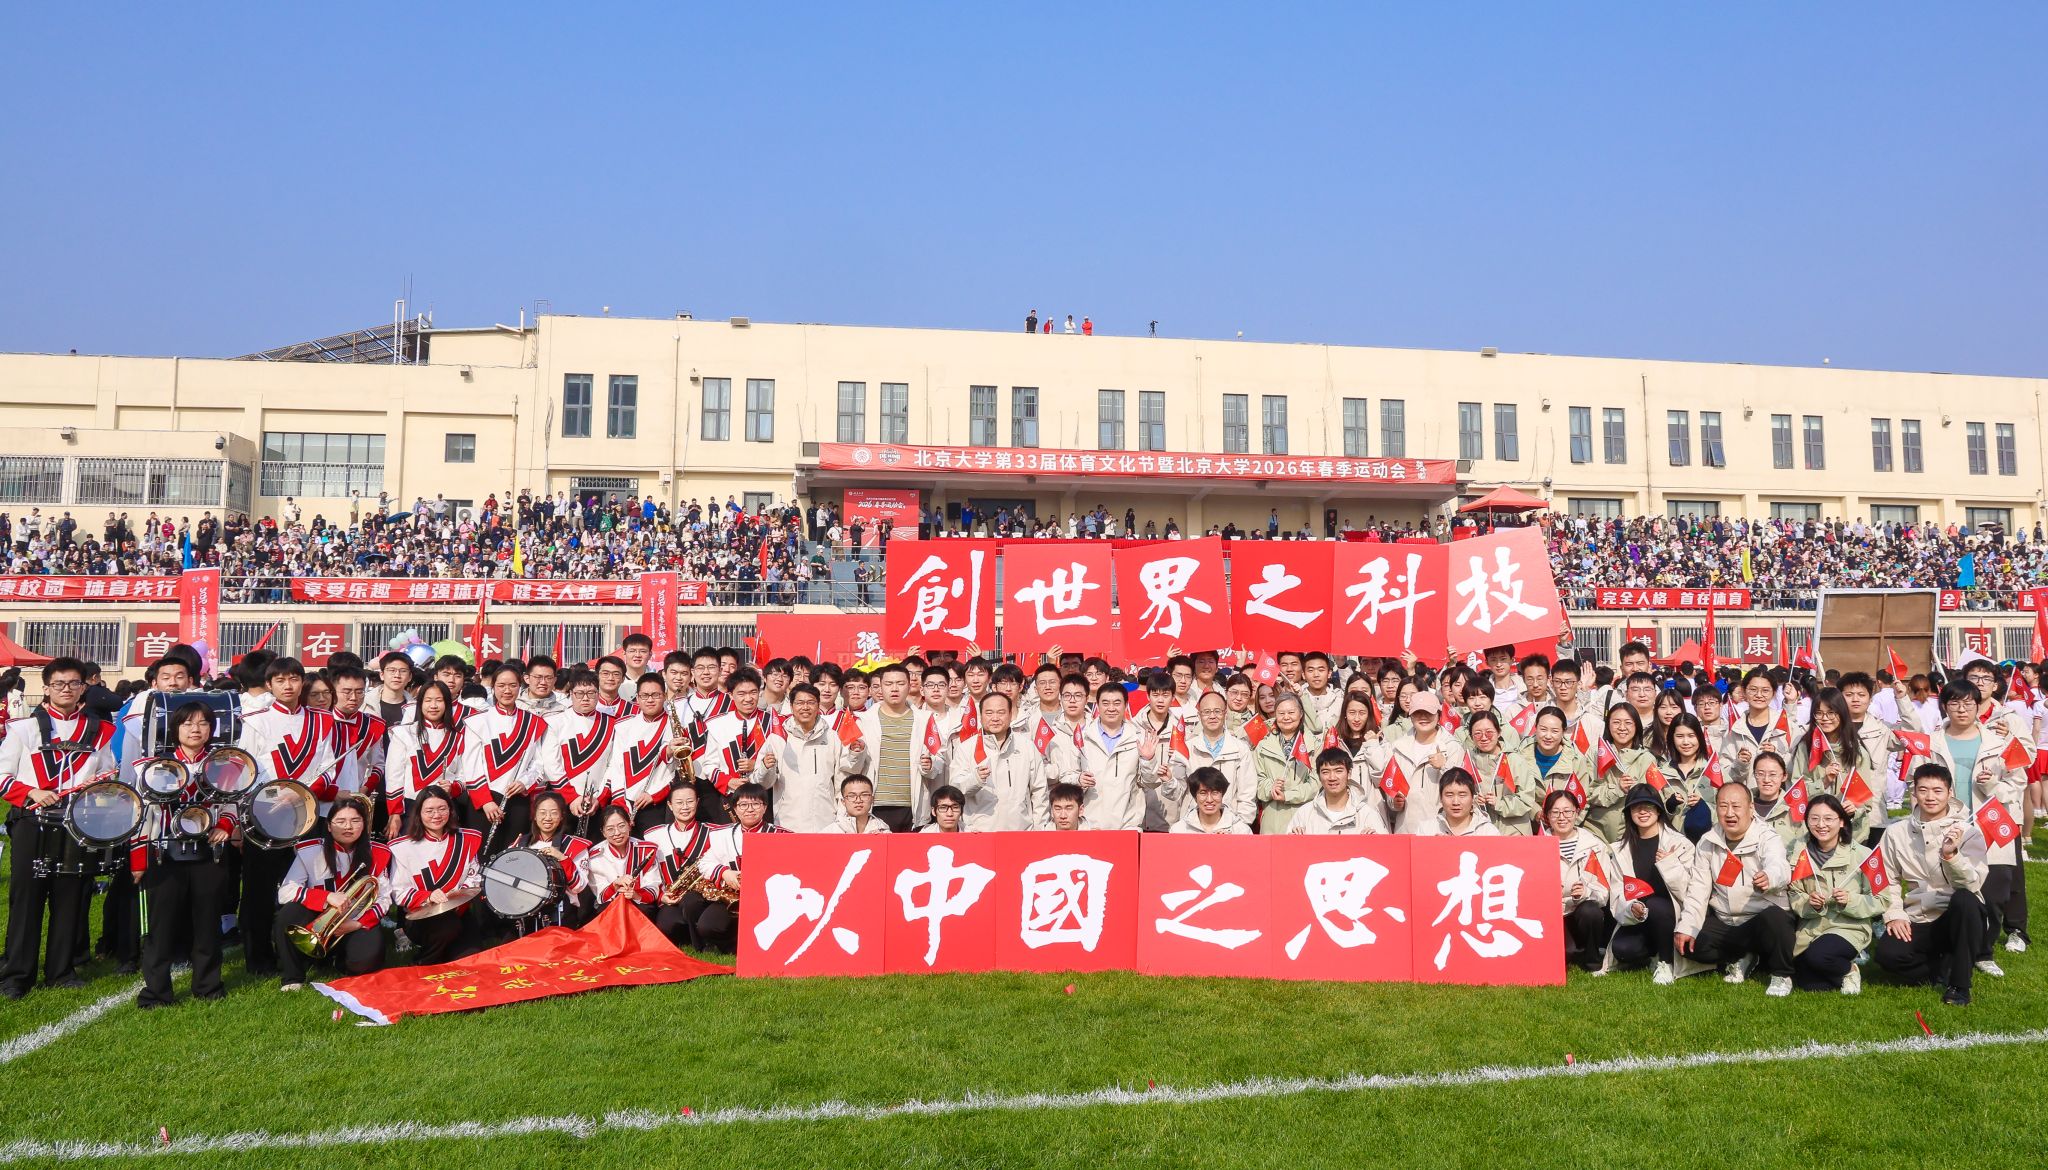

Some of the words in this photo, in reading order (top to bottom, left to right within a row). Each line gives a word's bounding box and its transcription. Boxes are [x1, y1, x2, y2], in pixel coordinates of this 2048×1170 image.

[913, 450, 1406, 479] 北京大学第33届体育文化节暨北京大学2026年春季运动会
[84, 580, 177, 597] 体育先行
[304, 582, 391, 599] 享受乐趣
[408, 583, 495, 600] 增强体质
[512, 584, 599, 600] 健全人格
[615, 584, 700, 600] 锤志
[897, 547, 1548, 648] 創世界之科技
[1602, 591, 1668, 605] 完全人格
[1680, 592, 1743, 606] 首在体育
[137, 632, 178, 658] 首
[303, 631, 340, 658] 在
[1744, 635, 1773, 656] 康
[754, 845, 1544, 971] 以中國之思想
